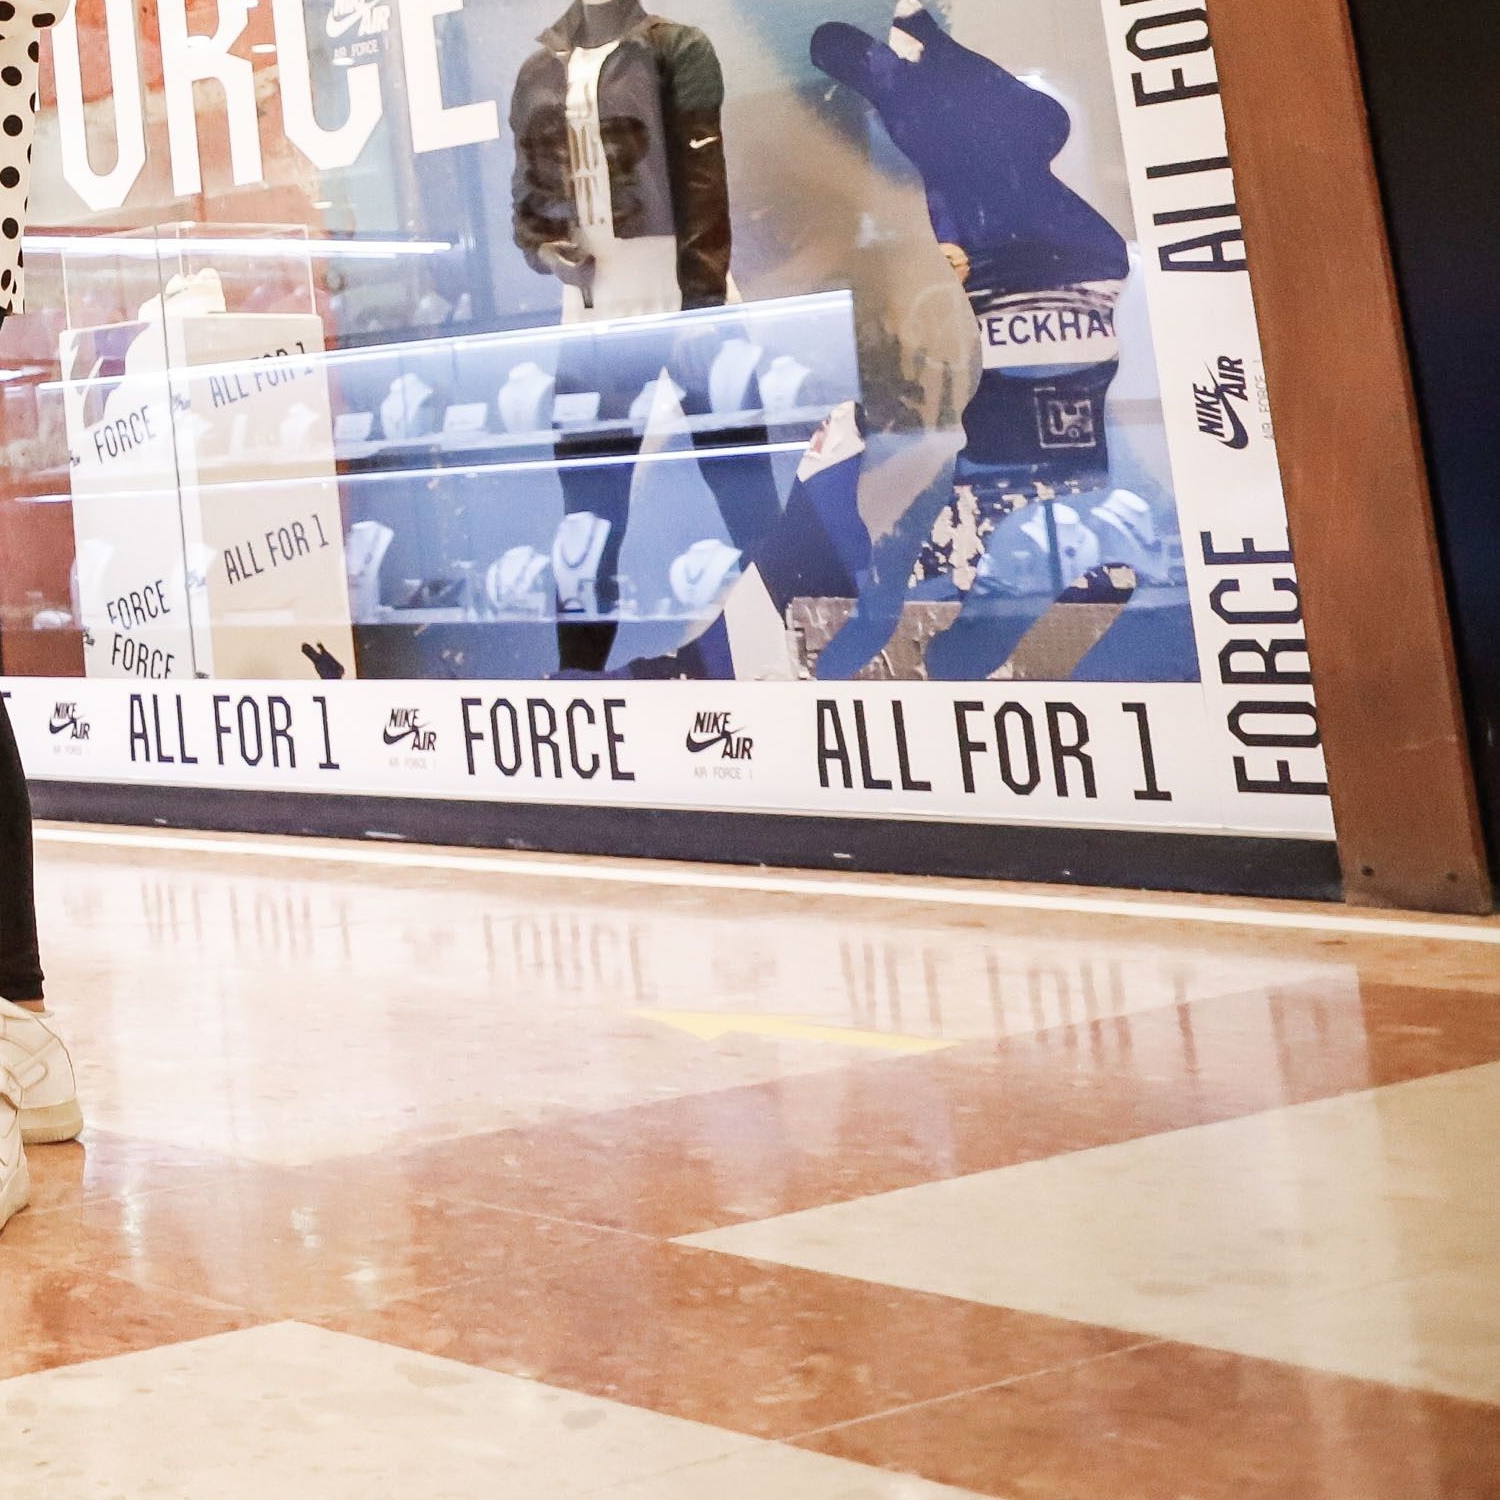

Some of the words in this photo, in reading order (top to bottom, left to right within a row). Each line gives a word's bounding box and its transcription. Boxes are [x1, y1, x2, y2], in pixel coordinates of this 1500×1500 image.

[358, 4, 391, 37] AIR
[978, 308, 1116, 346] ECKHA
[1217, 355, 1249, 401] AIR
[1193, 382, 1226, 437] NIKE
[93, 405, 157, 464] FORCE
[223, 541, 264, 585] ALL
[265, 521, 311, 567] FOR
[311, 513, 330, 548] 1
[106, 579, 171, 631] FORCE
[1200, 530, 1329, 795] FORCE
[54, 702, 78, 720] NIKE
[71, 723, 90, 740] AIR
[130, 693, 199, 764] ALL
[213, 695, 297, 768] FOR
[312, 696, 340, 770] 1
[389, 707, 420, 727] NIKE
[693, 711, 732, 734] NIKE
[411, 730, 438, 751] AIR
[461, 697, 636, 781] FORCE
[721, 731, 754, 760] AIR
[816, 699, 932, 792] ALL
[953, 700, 1098, 798] FOR
[1122, 702, 1173, 801] 1
